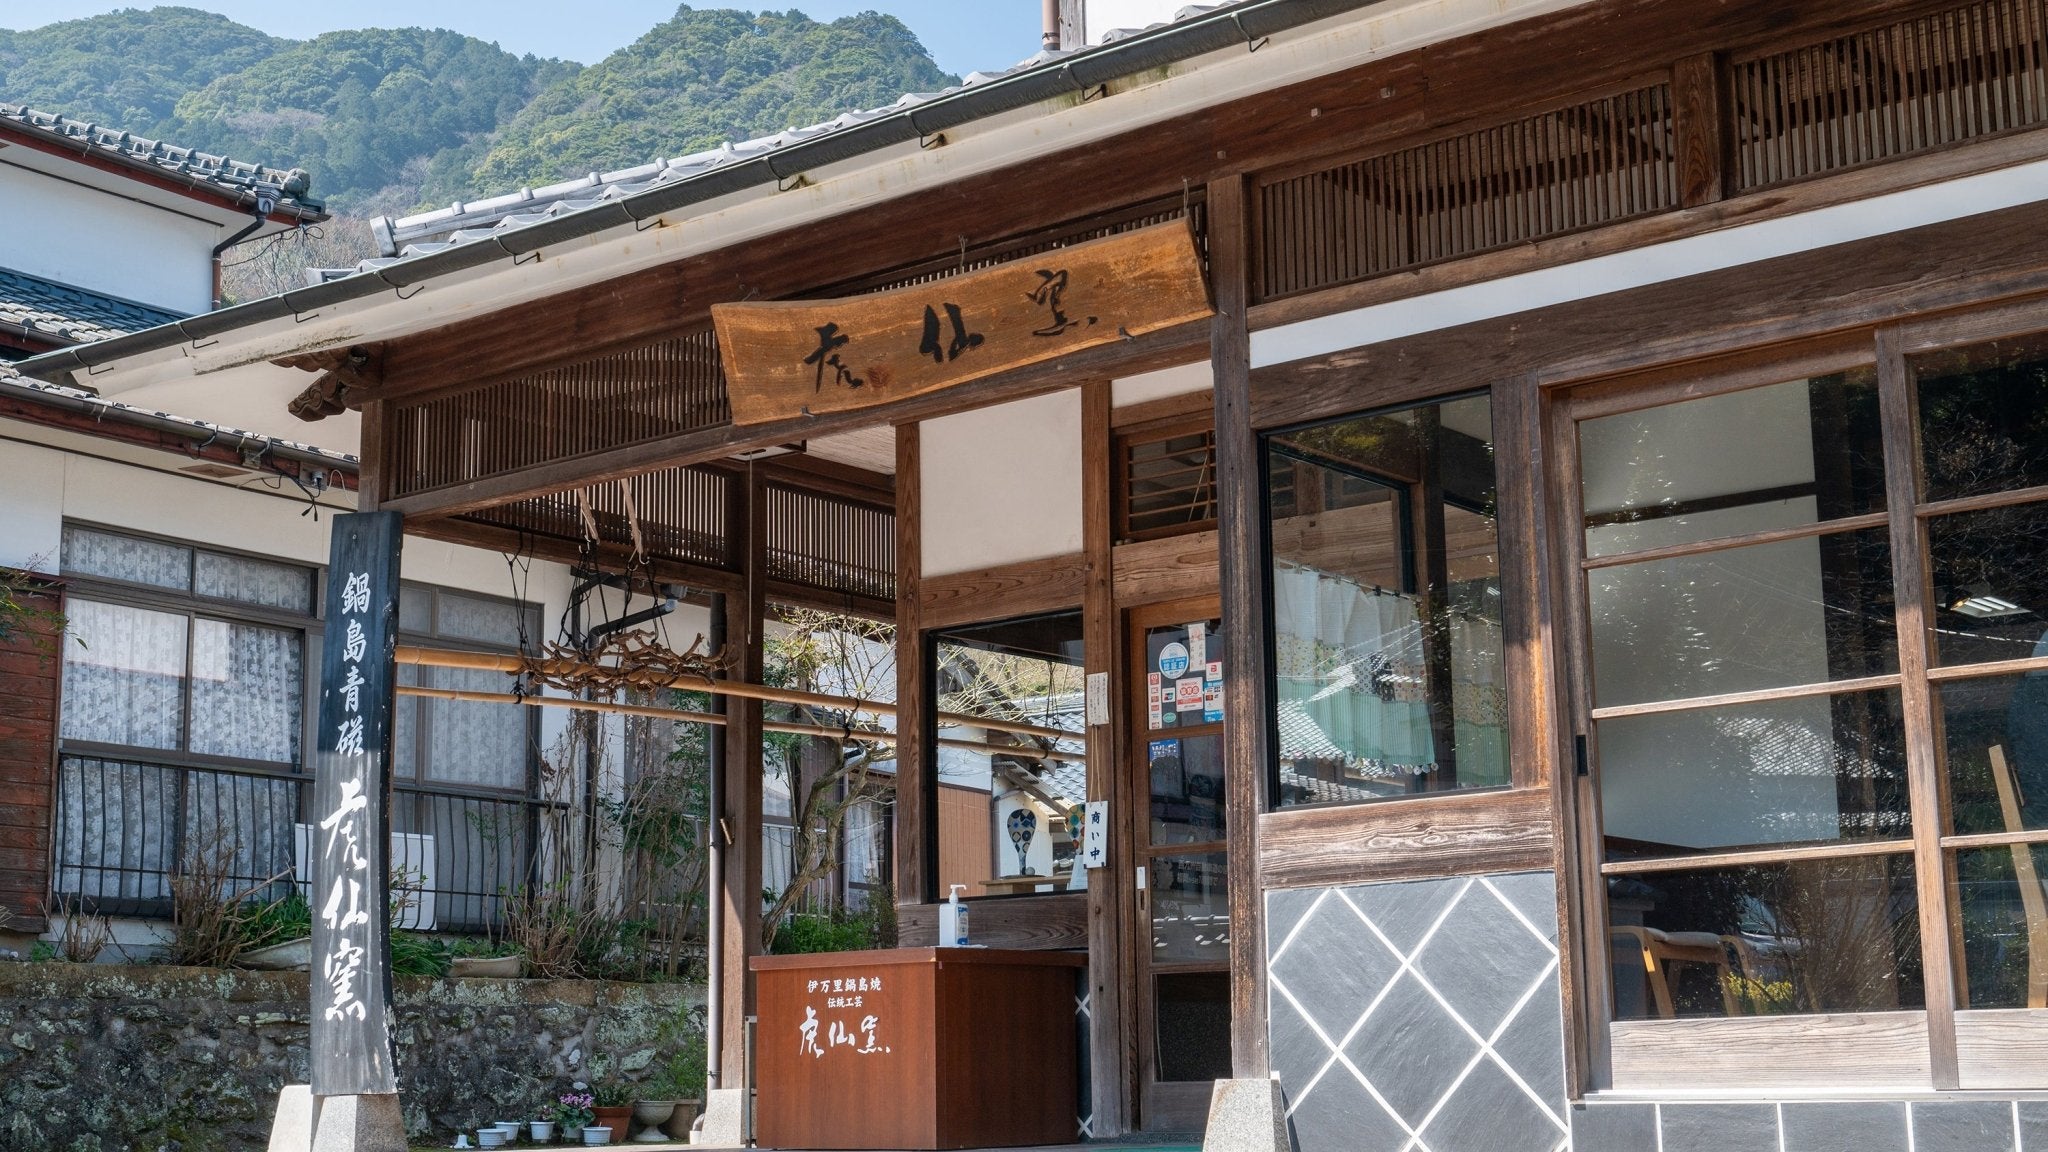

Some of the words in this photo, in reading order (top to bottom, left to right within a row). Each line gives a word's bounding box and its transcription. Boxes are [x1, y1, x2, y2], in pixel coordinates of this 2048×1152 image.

[804, 268, 1098, 393] 虎仙窯
[336, 571, 371, 757] 鍋島青磁
[1089, 811, 1101, 861] 商い中
[321, 778, 369, 1022] 虎仙窯
[807, 976, 882, 993] 伊万里鍋島焼
[827, 996, 863, 1009] 伝統工芸
[799, 1005, 892, 1059] 虎仙窯
